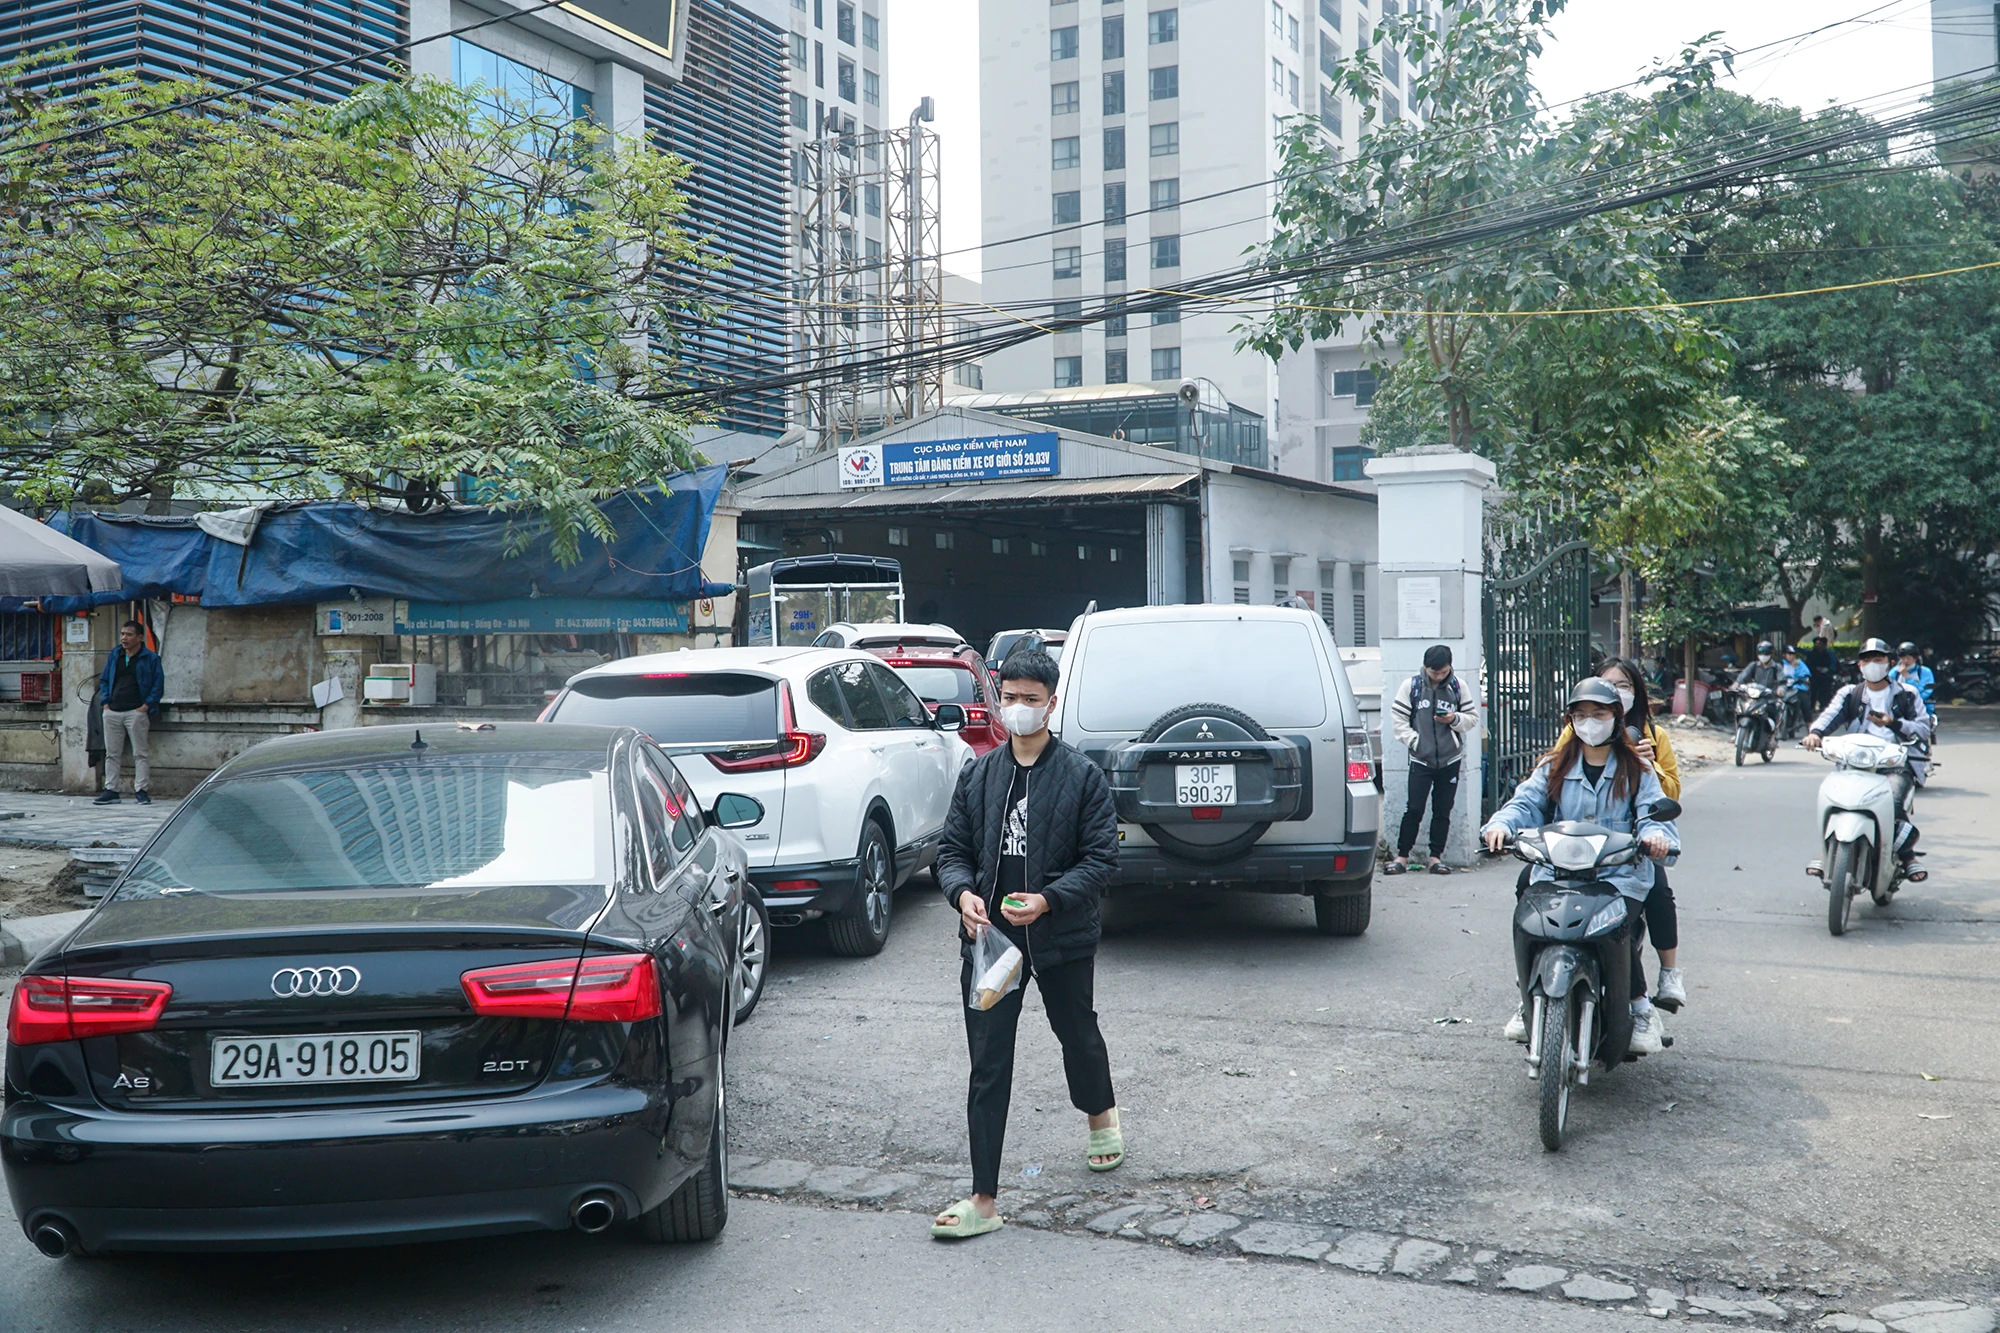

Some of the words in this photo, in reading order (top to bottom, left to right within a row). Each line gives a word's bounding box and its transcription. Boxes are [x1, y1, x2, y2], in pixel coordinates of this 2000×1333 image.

[913, 446, 932, 455] CỤC
[935, 443, 961, 452] ĐĂNG
[963, 439, 984, 450] KIỂM
[986, 439, 1003, 450] VIỆT
[1005, 439, 1027, 447] NAM
[889, 461, 913, 474] TRUNG
[914, 458, 930, 473] TÂM
[931, 457, 951, 472] ĐĂNG
[953, 452, 971, 470] KIỂM
[973, 456, 983, 469] XE
[984, 454, 994, 468] CƠ
[996, 451, 1011, 467] GIỚI
[1013, 449, 1023, 466] SỐ
[1025, 452, 1050, 465] 29.03V
[617, 618, 631, 627] Fax:
[794, 610, 813, 619] 29H-
[1191, 766, 1220, 783] 30F
[1179, 785, 1233, 803] 590.37
[221, 1038, 411, 1080] 29A-918.05
[483, 1060, 529, 1072] 2.0T
[113, 1073, 149, 1088] A6
